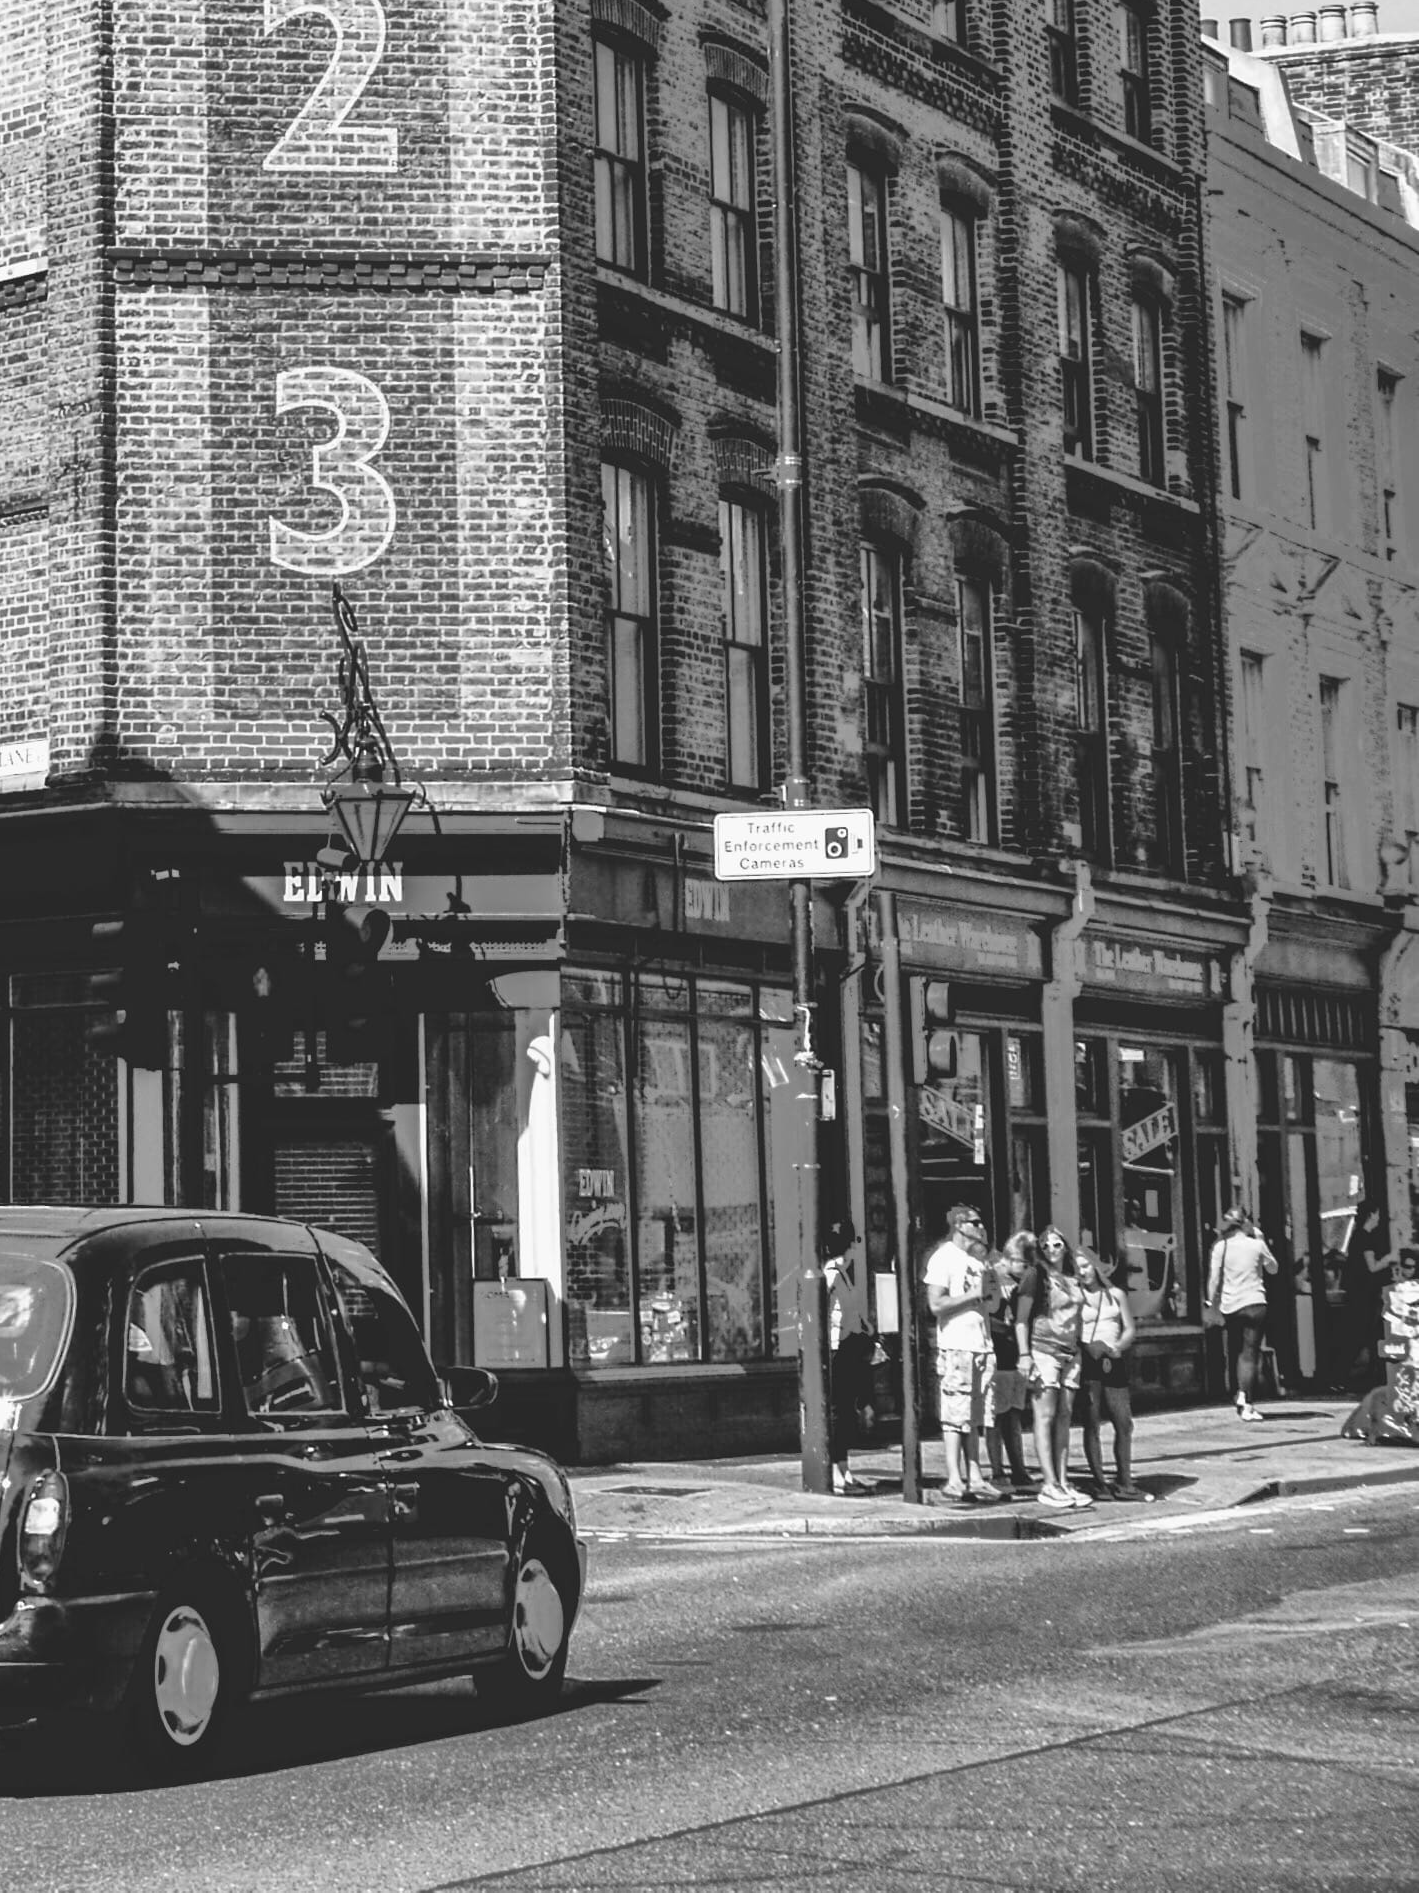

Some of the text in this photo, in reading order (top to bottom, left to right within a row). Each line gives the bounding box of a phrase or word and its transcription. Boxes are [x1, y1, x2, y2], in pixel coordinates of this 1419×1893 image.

[268, 368, 397, 577] 3
[747, 821, 795, 835] Traffic
[724, 839, 819, 853] Enforcement
[739, 856, 805, 870] Cameras
[283, 861, 403, 902] EDWIN
[684, 877, 731, 922] EDWIN
[1122, 1108, 1171, 1160] SALE
[578, 1168, 615, 1198] EDWIN
